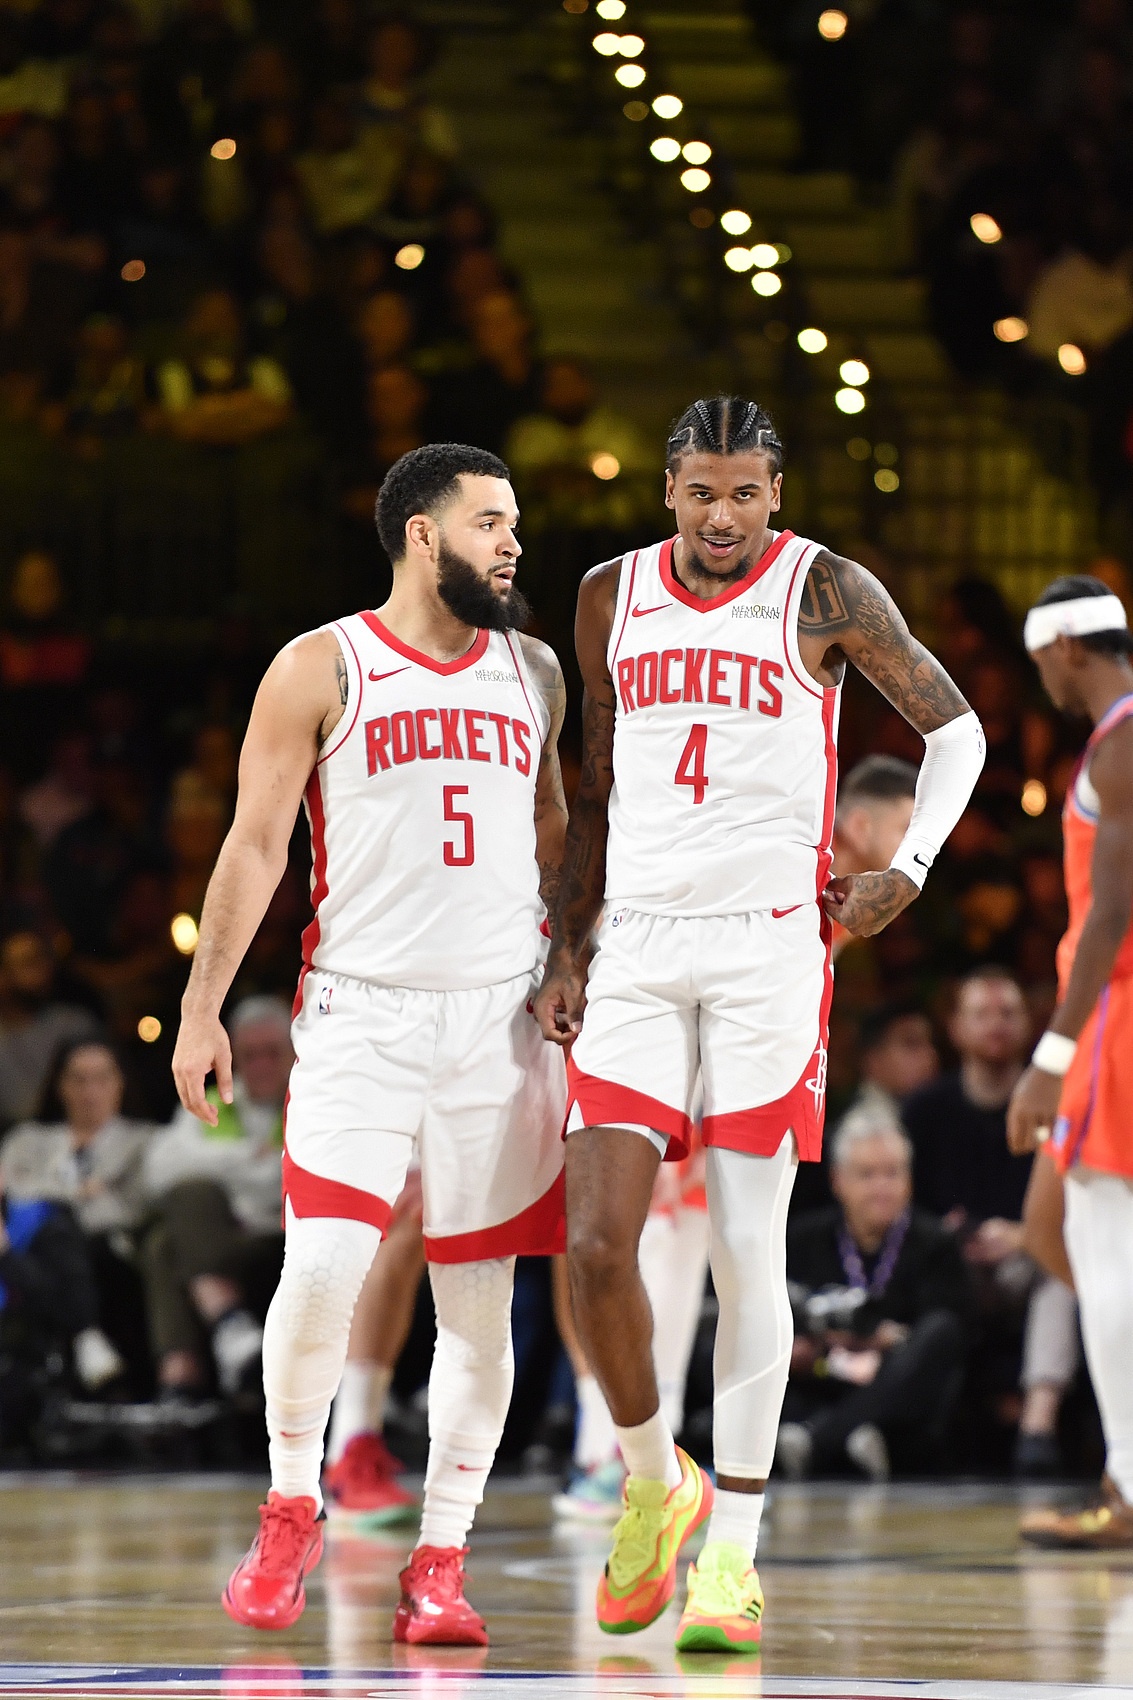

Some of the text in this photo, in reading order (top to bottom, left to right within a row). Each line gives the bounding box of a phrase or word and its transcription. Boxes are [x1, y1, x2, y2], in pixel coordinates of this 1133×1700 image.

[731, 611, 780, 619] HERMANN
[732, 604, 780, 614] MEMORIAL
[617, 648, 784, 718] ROCKETS
[364, 708, 531, 778] ROCKETS
[674, 723, 709, 805] 4
[443, 785, 475, 867] 5
